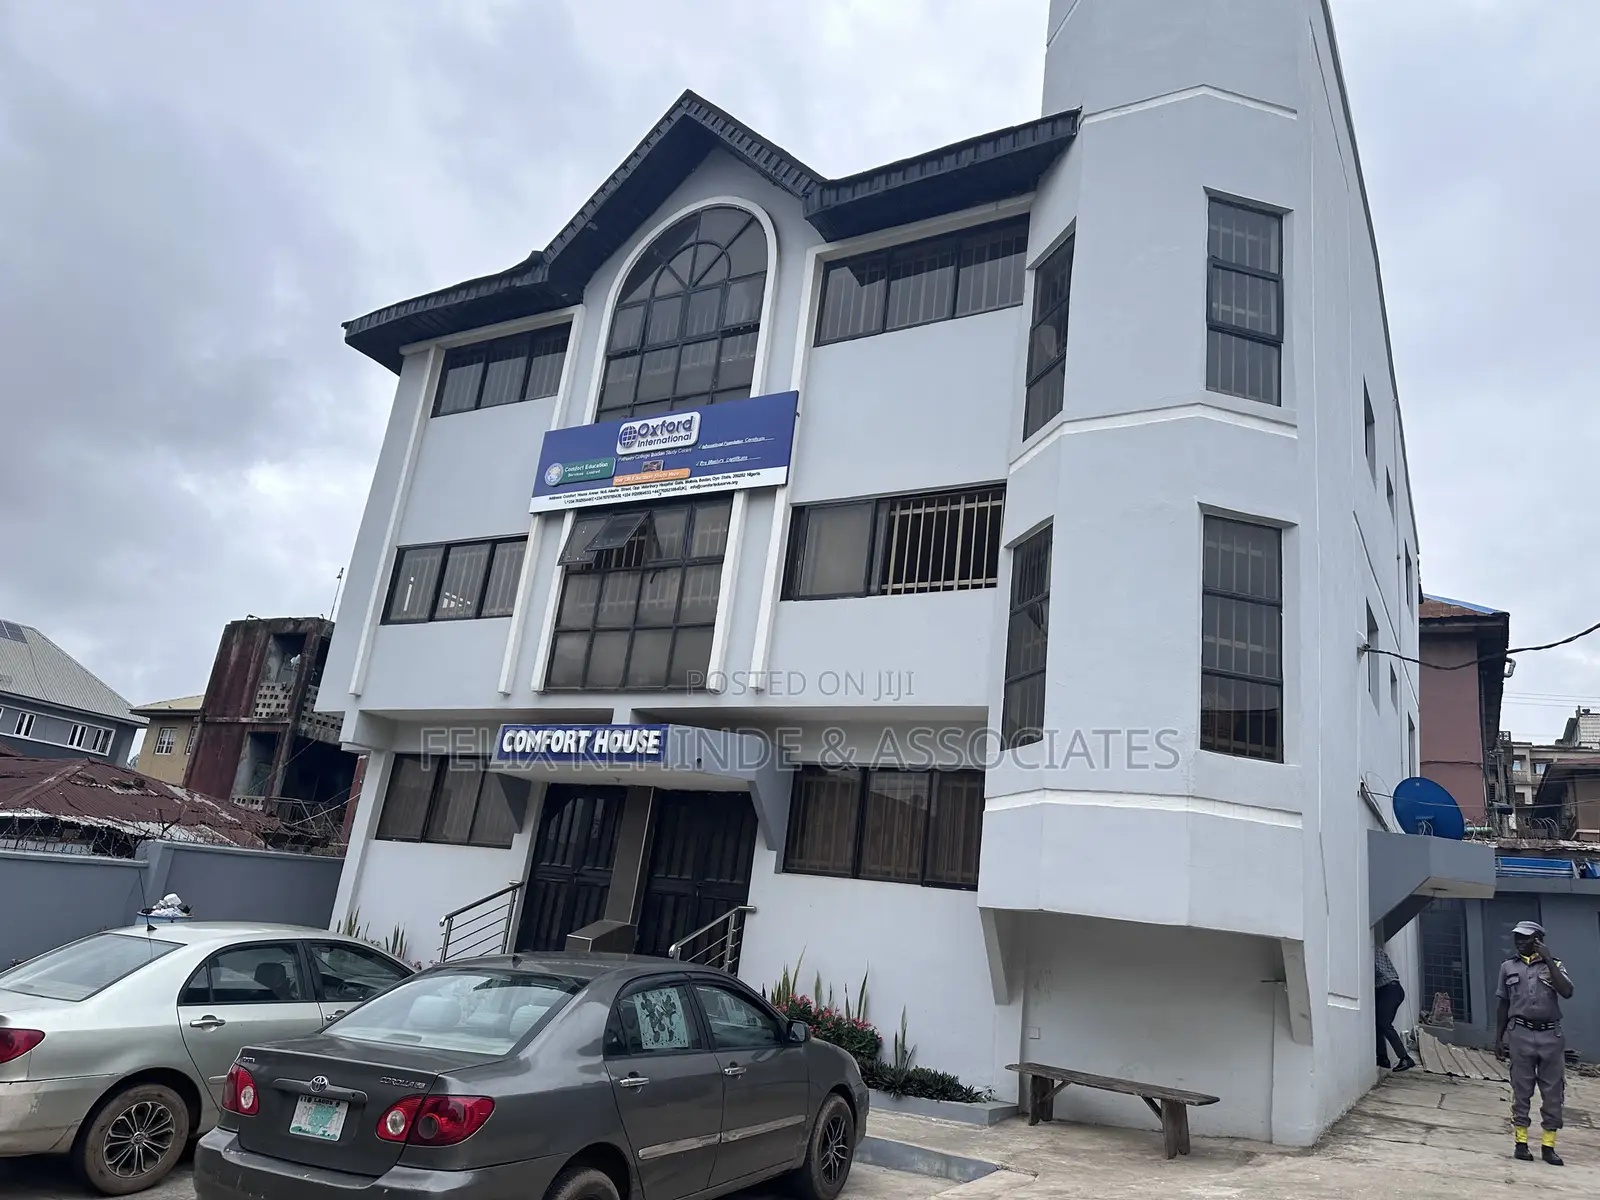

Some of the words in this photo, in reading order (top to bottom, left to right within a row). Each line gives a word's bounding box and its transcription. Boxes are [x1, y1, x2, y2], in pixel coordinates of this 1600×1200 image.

[638, 416, 693, 437] Oxford
[637, 432, 692, 448] International
[564, 465, 584, 473] Comfort
[585, 462, 608, 470] Education
[501, 729, 592, 754] COMFORT
[593, 729, 662, 755] HOUSE
